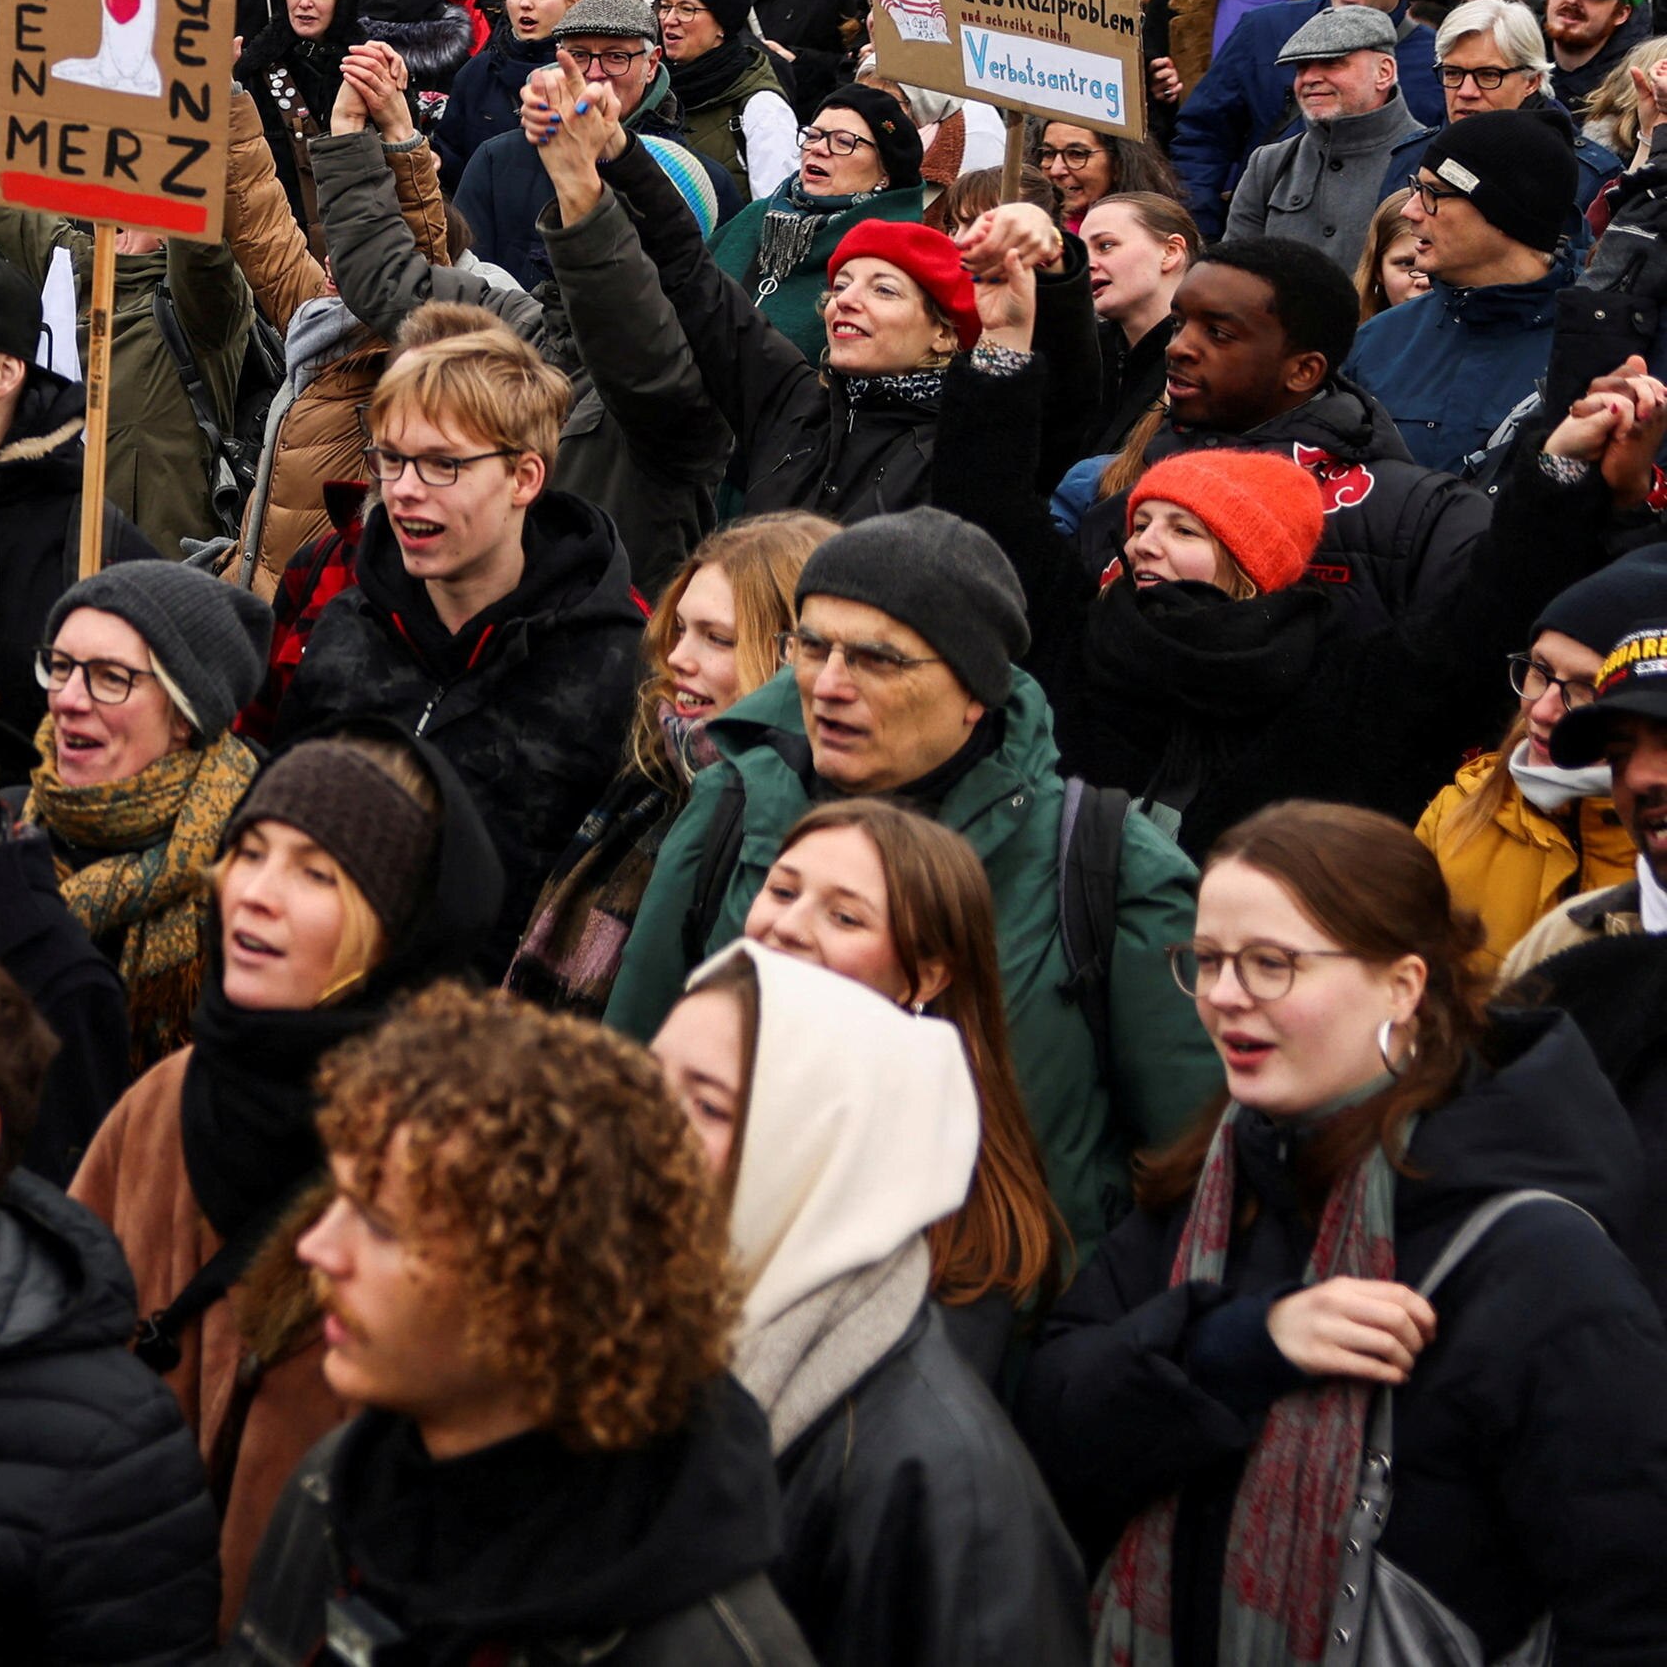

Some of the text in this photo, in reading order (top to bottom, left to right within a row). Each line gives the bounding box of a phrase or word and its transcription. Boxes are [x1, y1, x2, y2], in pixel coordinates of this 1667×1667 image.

[960, 10, 1072, 44] und schreibt einen
[964, 30, 1121, 118] Verbotsantrag
[5, 114, 212, 200] MERZ
